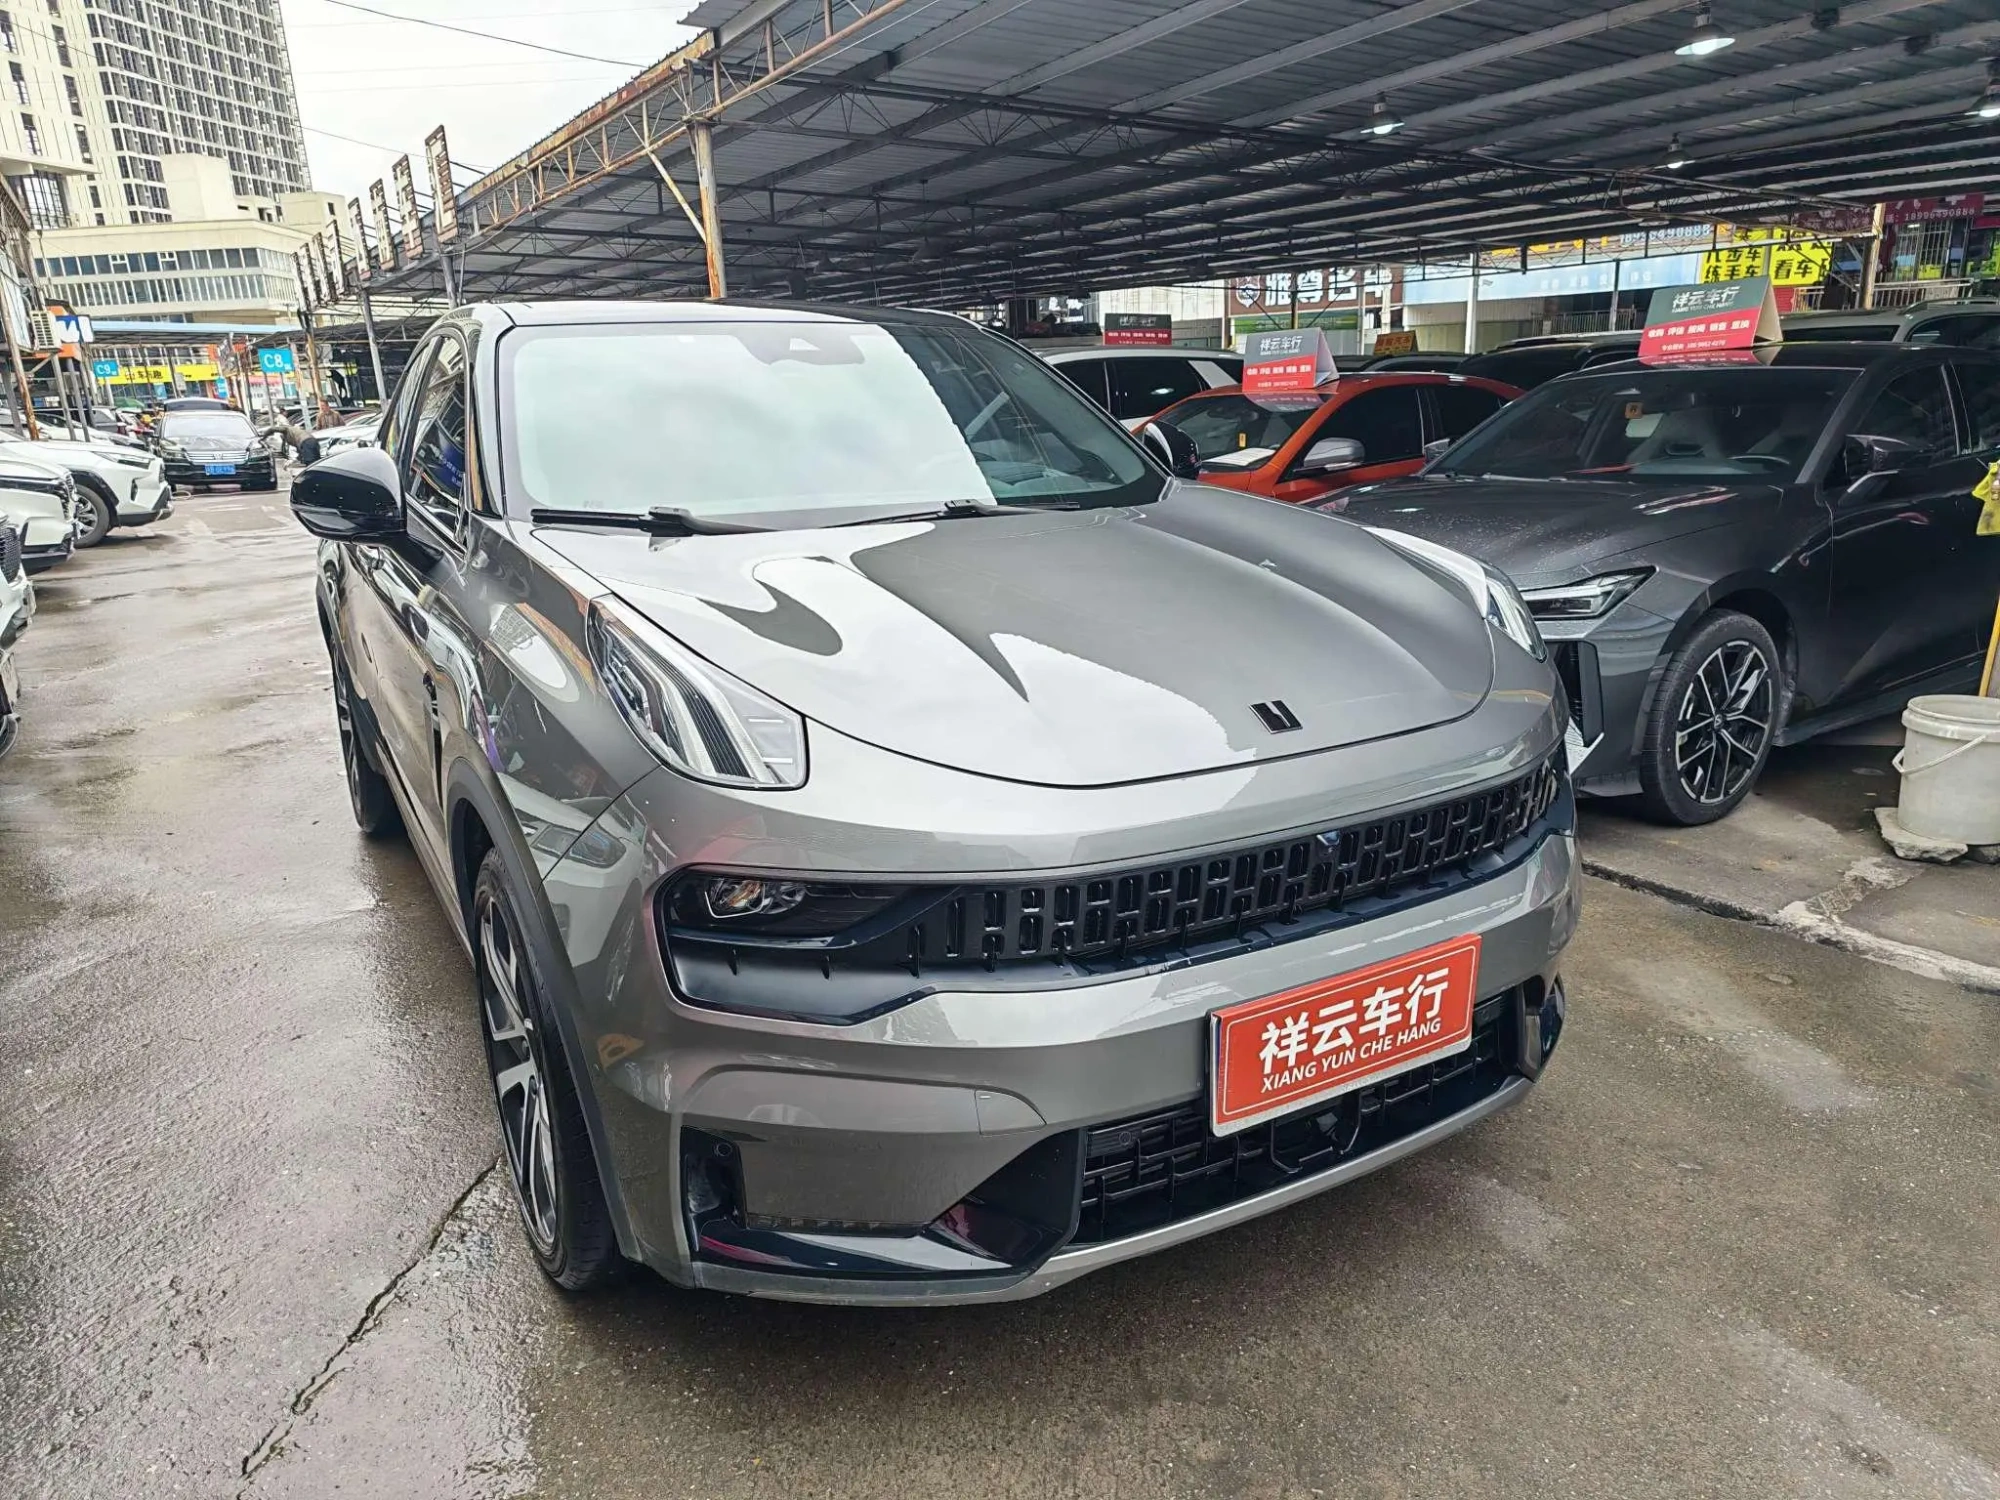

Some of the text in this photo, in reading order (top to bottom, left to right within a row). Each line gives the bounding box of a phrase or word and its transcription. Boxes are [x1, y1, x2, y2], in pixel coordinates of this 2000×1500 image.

[1672, 286, 1741, 309] 祥云车行
[1260, 336, 1303, 351] 祥云车行
[1259, 967, 1450, 1075] 祥云车行
[1260, 1017, 1442, 1094] XIANG YUN CHE HANG
